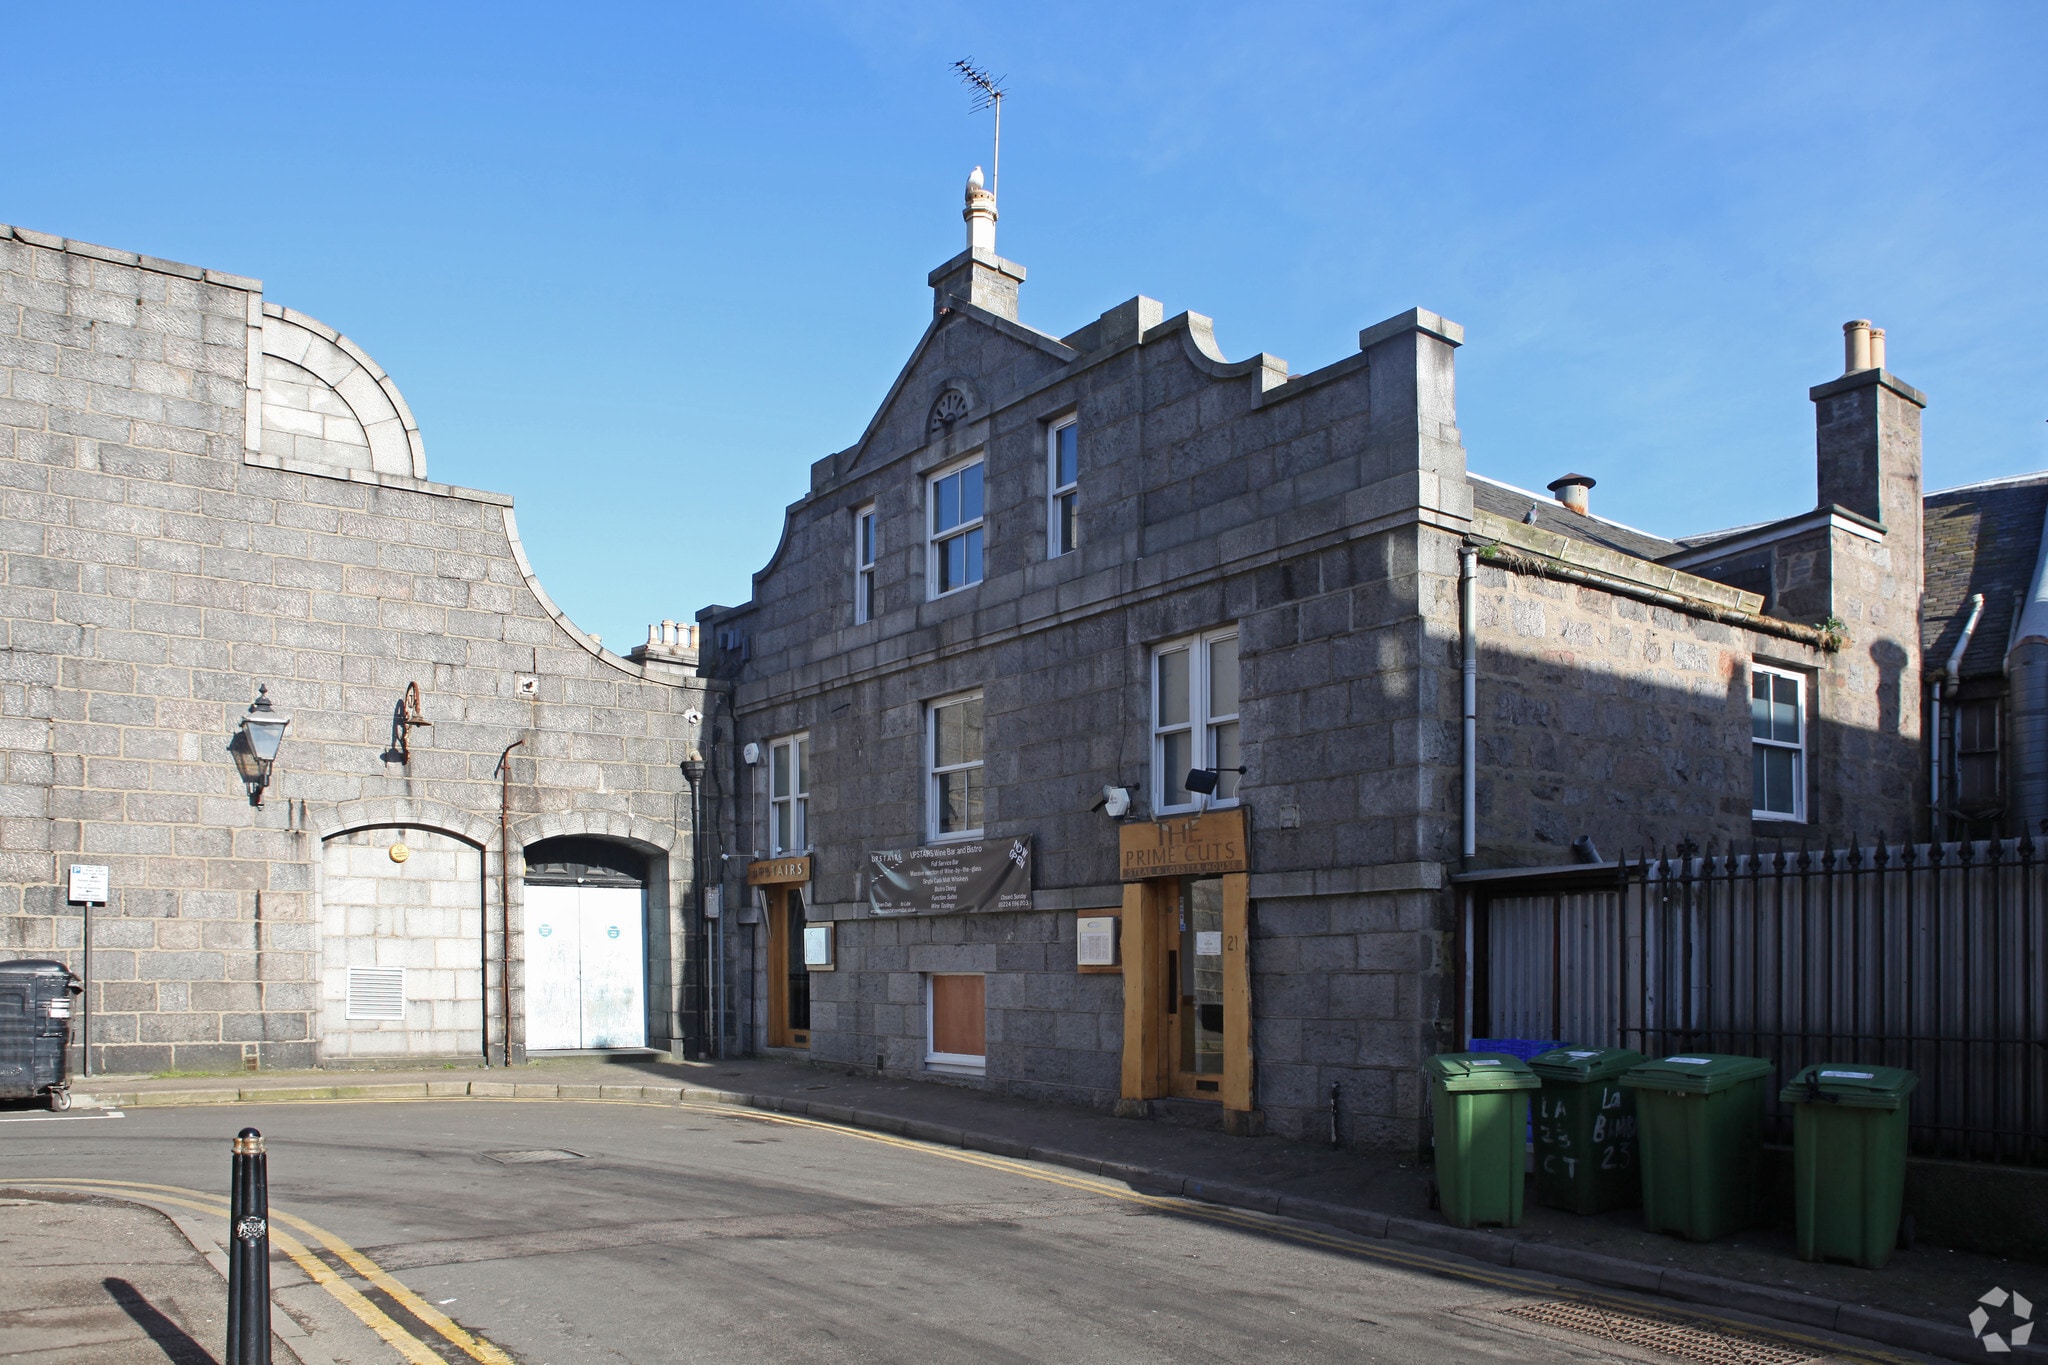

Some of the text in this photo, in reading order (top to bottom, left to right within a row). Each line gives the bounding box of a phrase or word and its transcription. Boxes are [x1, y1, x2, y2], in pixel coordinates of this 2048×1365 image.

[1154, 817, 1203, 847] THE
[871, 853, 903, 863] UPSTAIRS
[910, 845, 983, 859] UPSTAIRS Wine Bar and Bistro
[1013, 839, 1029, 858] NOW
[1126, 841, 1236, 867] PRIME CUTS
[1008, 848, 1026, 869] OPEN
[752, 863, 803, 879] UPSTAIRS
[1128, 867, 1153, 877] STEAK
[1166, 863, 1202, 874] LOBSTER
[1207, 861, 1238, 871] HOUSE
[1227, 935, 1238, 951] 21
[1601, 1087, 1621, 1110] La
[1601, 1143, 1632, 1169] 23
